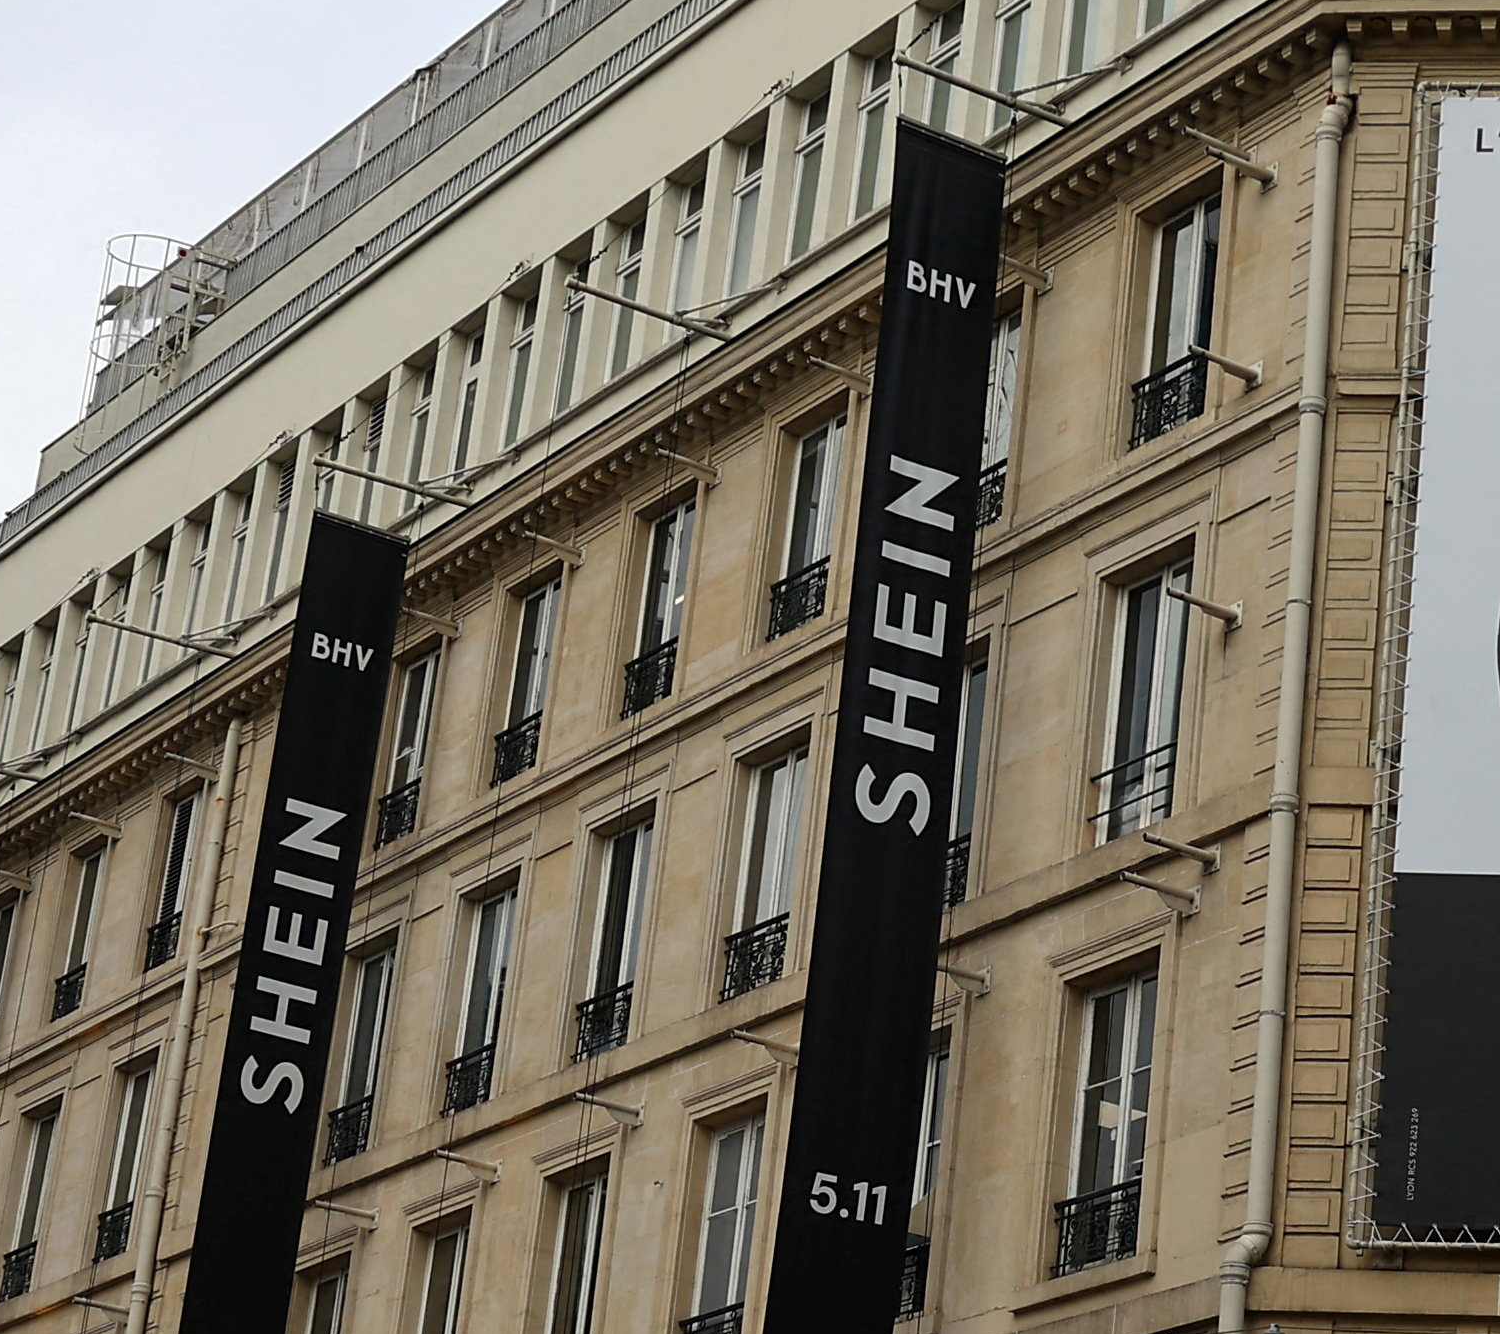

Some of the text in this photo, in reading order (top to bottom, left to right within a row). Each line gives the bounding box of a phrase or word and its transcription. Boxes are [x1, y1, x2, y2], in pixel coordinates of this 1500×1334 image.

[906, 259, 977, 309] BHV
[311, 632, 374, 672] BHV
[855, 454, 962, 837] SHEIN
[240, 798, 347, 1114] SHEIN
[1407, 1158, 1417, 1176] RCS
[1408, 1142, 1418, 1157] 922
[809, 1171, 888, 1226] 5.11
[1406, 1177, 1415, 1201] LYON
